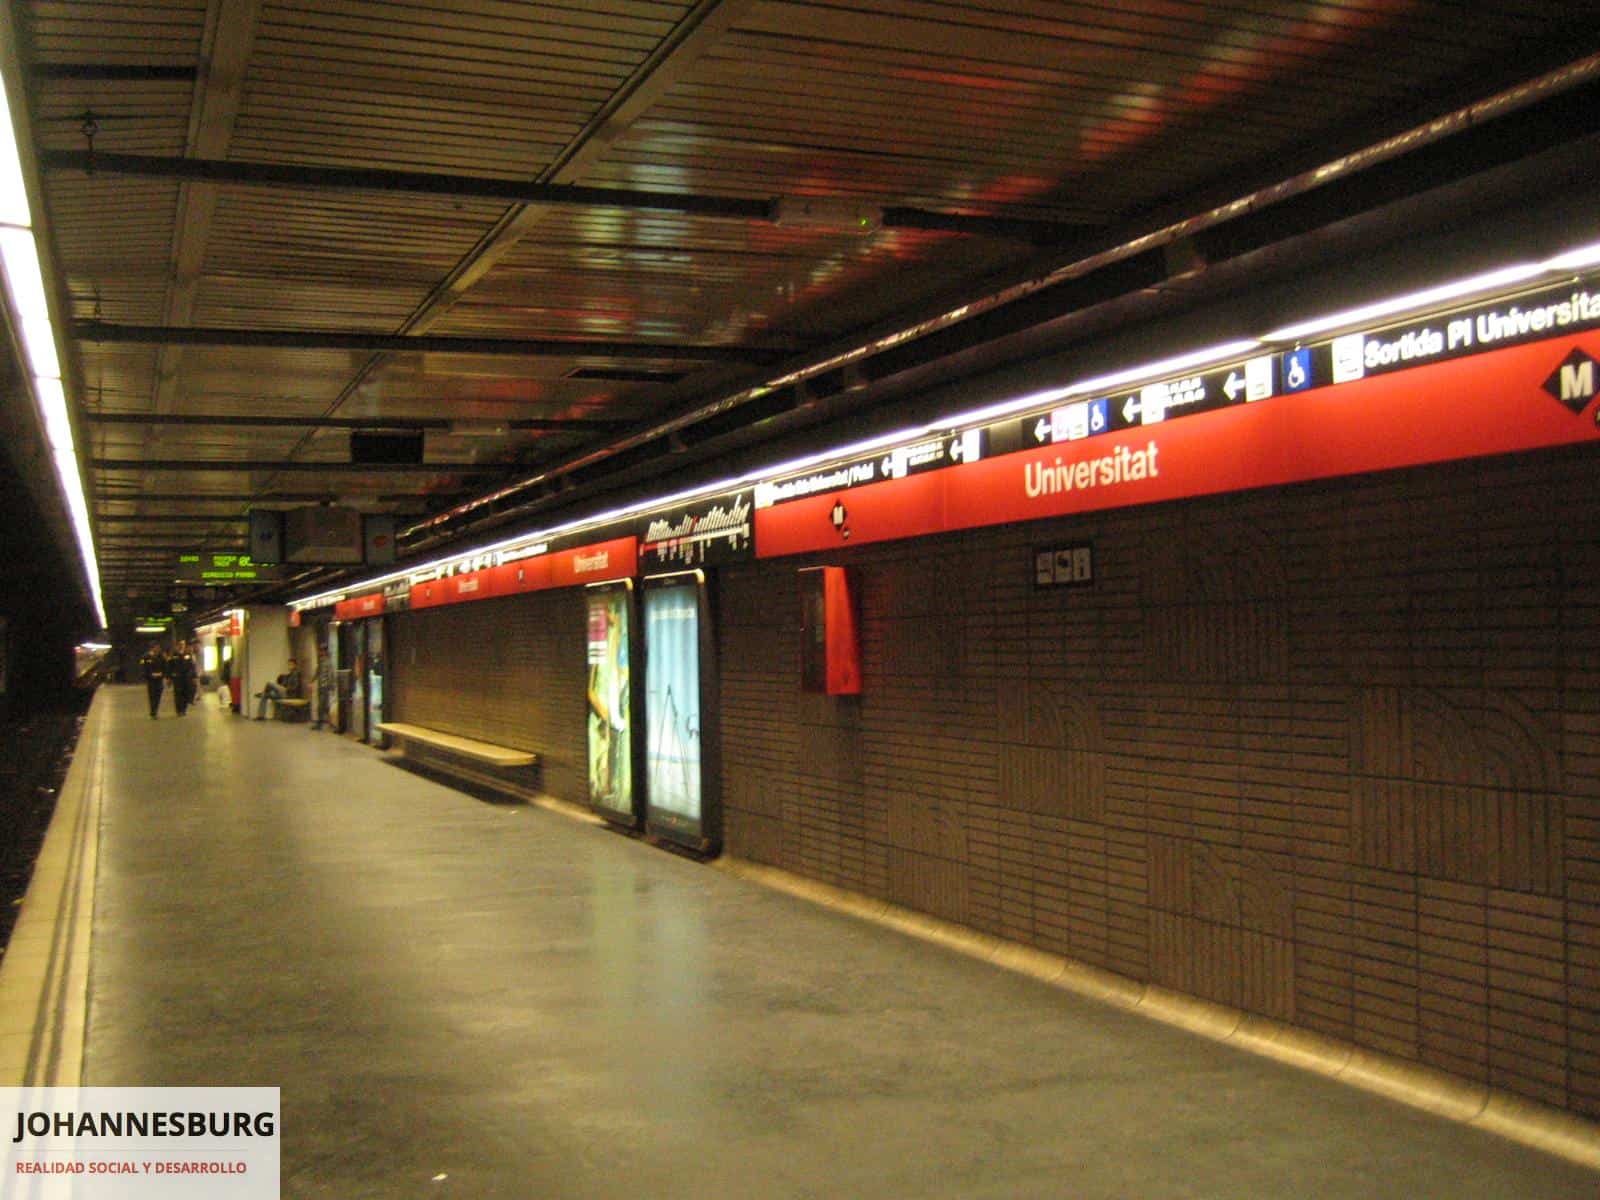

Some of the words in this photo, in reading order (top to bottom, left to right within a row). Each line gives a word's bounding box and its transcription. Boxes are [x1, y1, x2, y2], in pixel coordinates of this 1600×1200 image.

[1363, 327, 1443, 368] Sortida
[1560, 360, 1594, 401] M
[1024, 440, 1159, 497] Universitat
